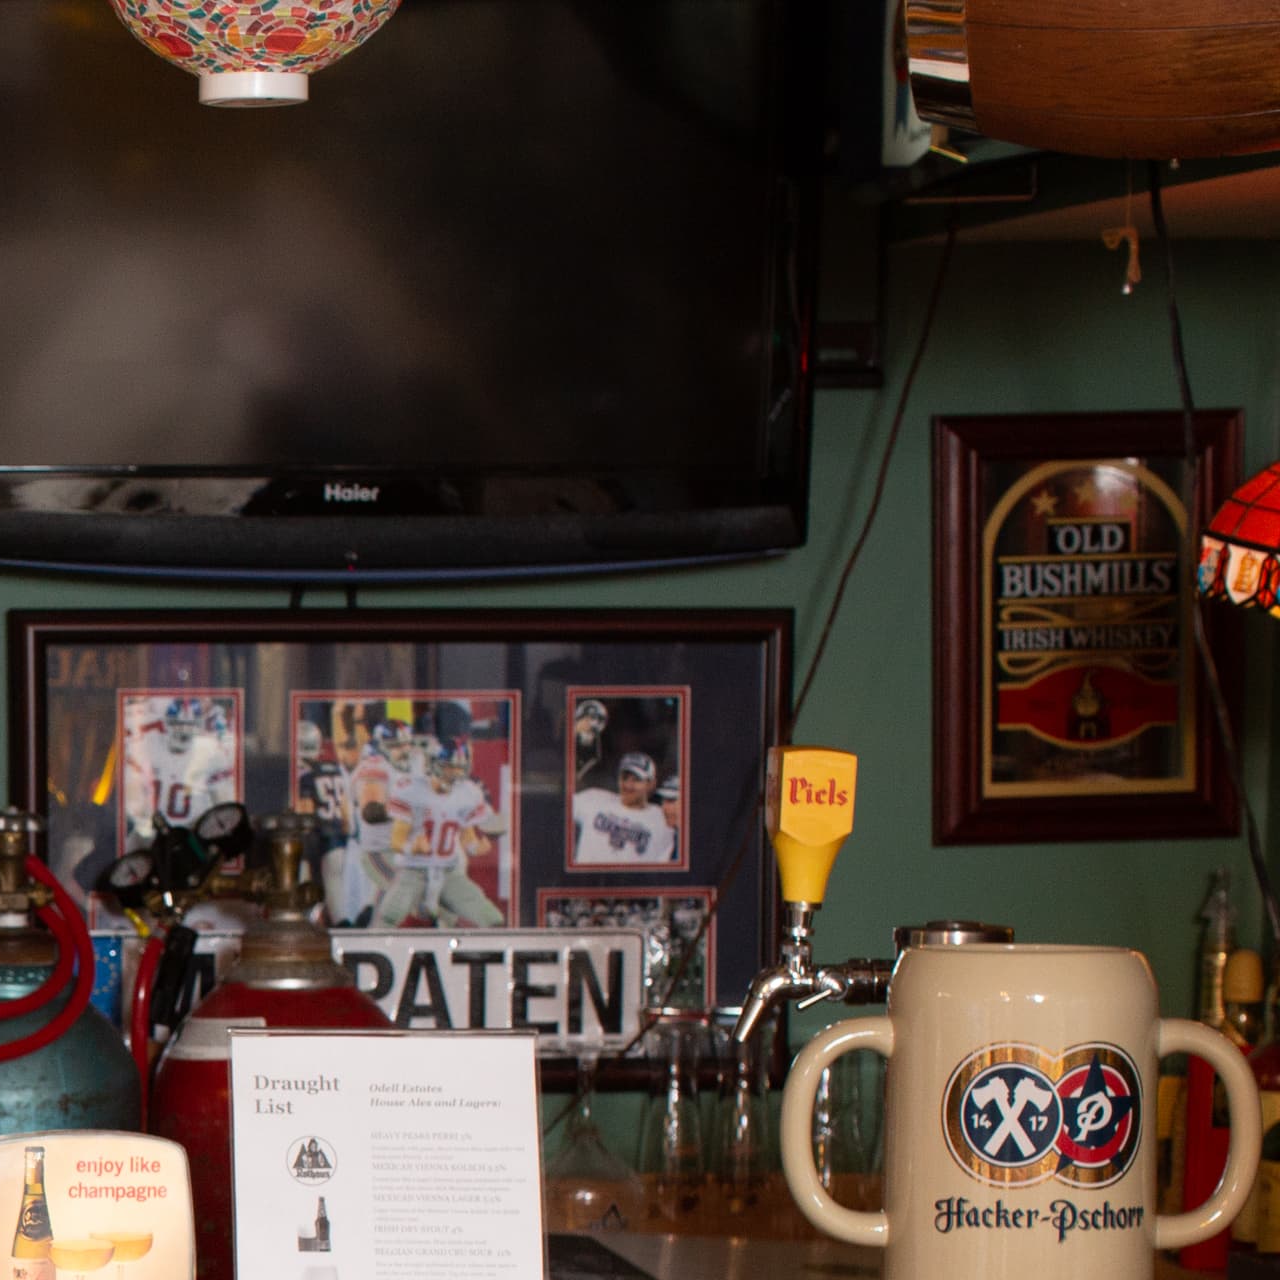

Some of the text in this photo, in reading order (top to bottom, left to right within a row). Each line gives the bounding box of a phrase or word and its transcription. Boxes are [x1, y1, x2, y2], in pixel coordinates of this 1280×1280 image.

[324, 482, 380, 502] Haier
[1002, 624, 1174, 651] IRISH WHISKEY
[788, 777, 849, 806] Piels
[342, 949, 624, 1035] PATEN
[253, 1074, 341, 1095] Draught
[254, 1098, 293, 1115] List
[370, 1097, 406, 1108] House
[408, 1097, 432, 1108] Ales
[433, 1097, 457, 1108] and
[971, 1113, 1049, 1132] 14 17
[1074, 1091, 1113, 1142] P
[76, 1156, 161, 1177] enjoy like
[68, 1182, 168, 1202] champagne
[934, 1196, 1144, 1243] Hacker-Pschorr
